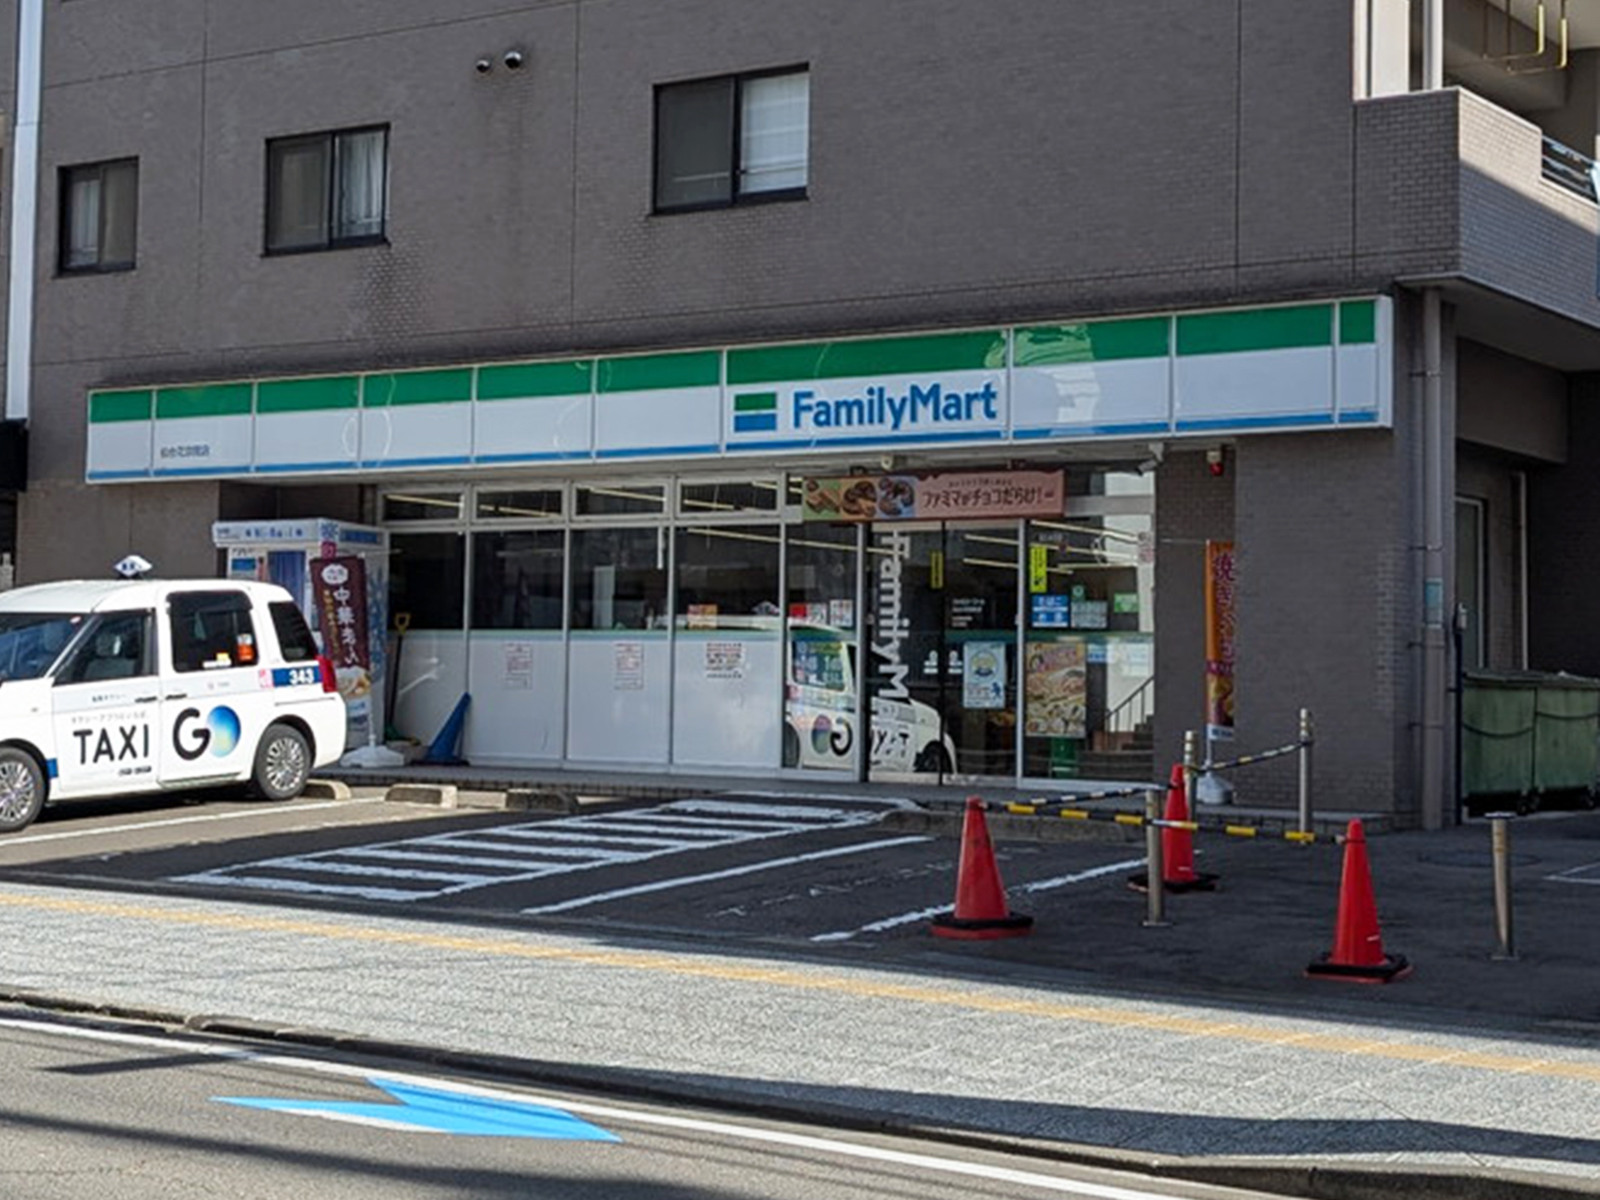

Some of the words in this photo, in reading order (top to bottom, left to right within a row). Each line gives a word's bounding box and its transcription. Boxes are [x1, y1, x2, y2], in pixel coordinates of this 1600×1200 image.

[793, 382, 997, 430] FamilyMart
[333, 586, 360, 664] 中華まん
[289, 668, 315, 684] 343
[73, 723, 149, 764] TAXI
[172, 704, 241, 761] GO
